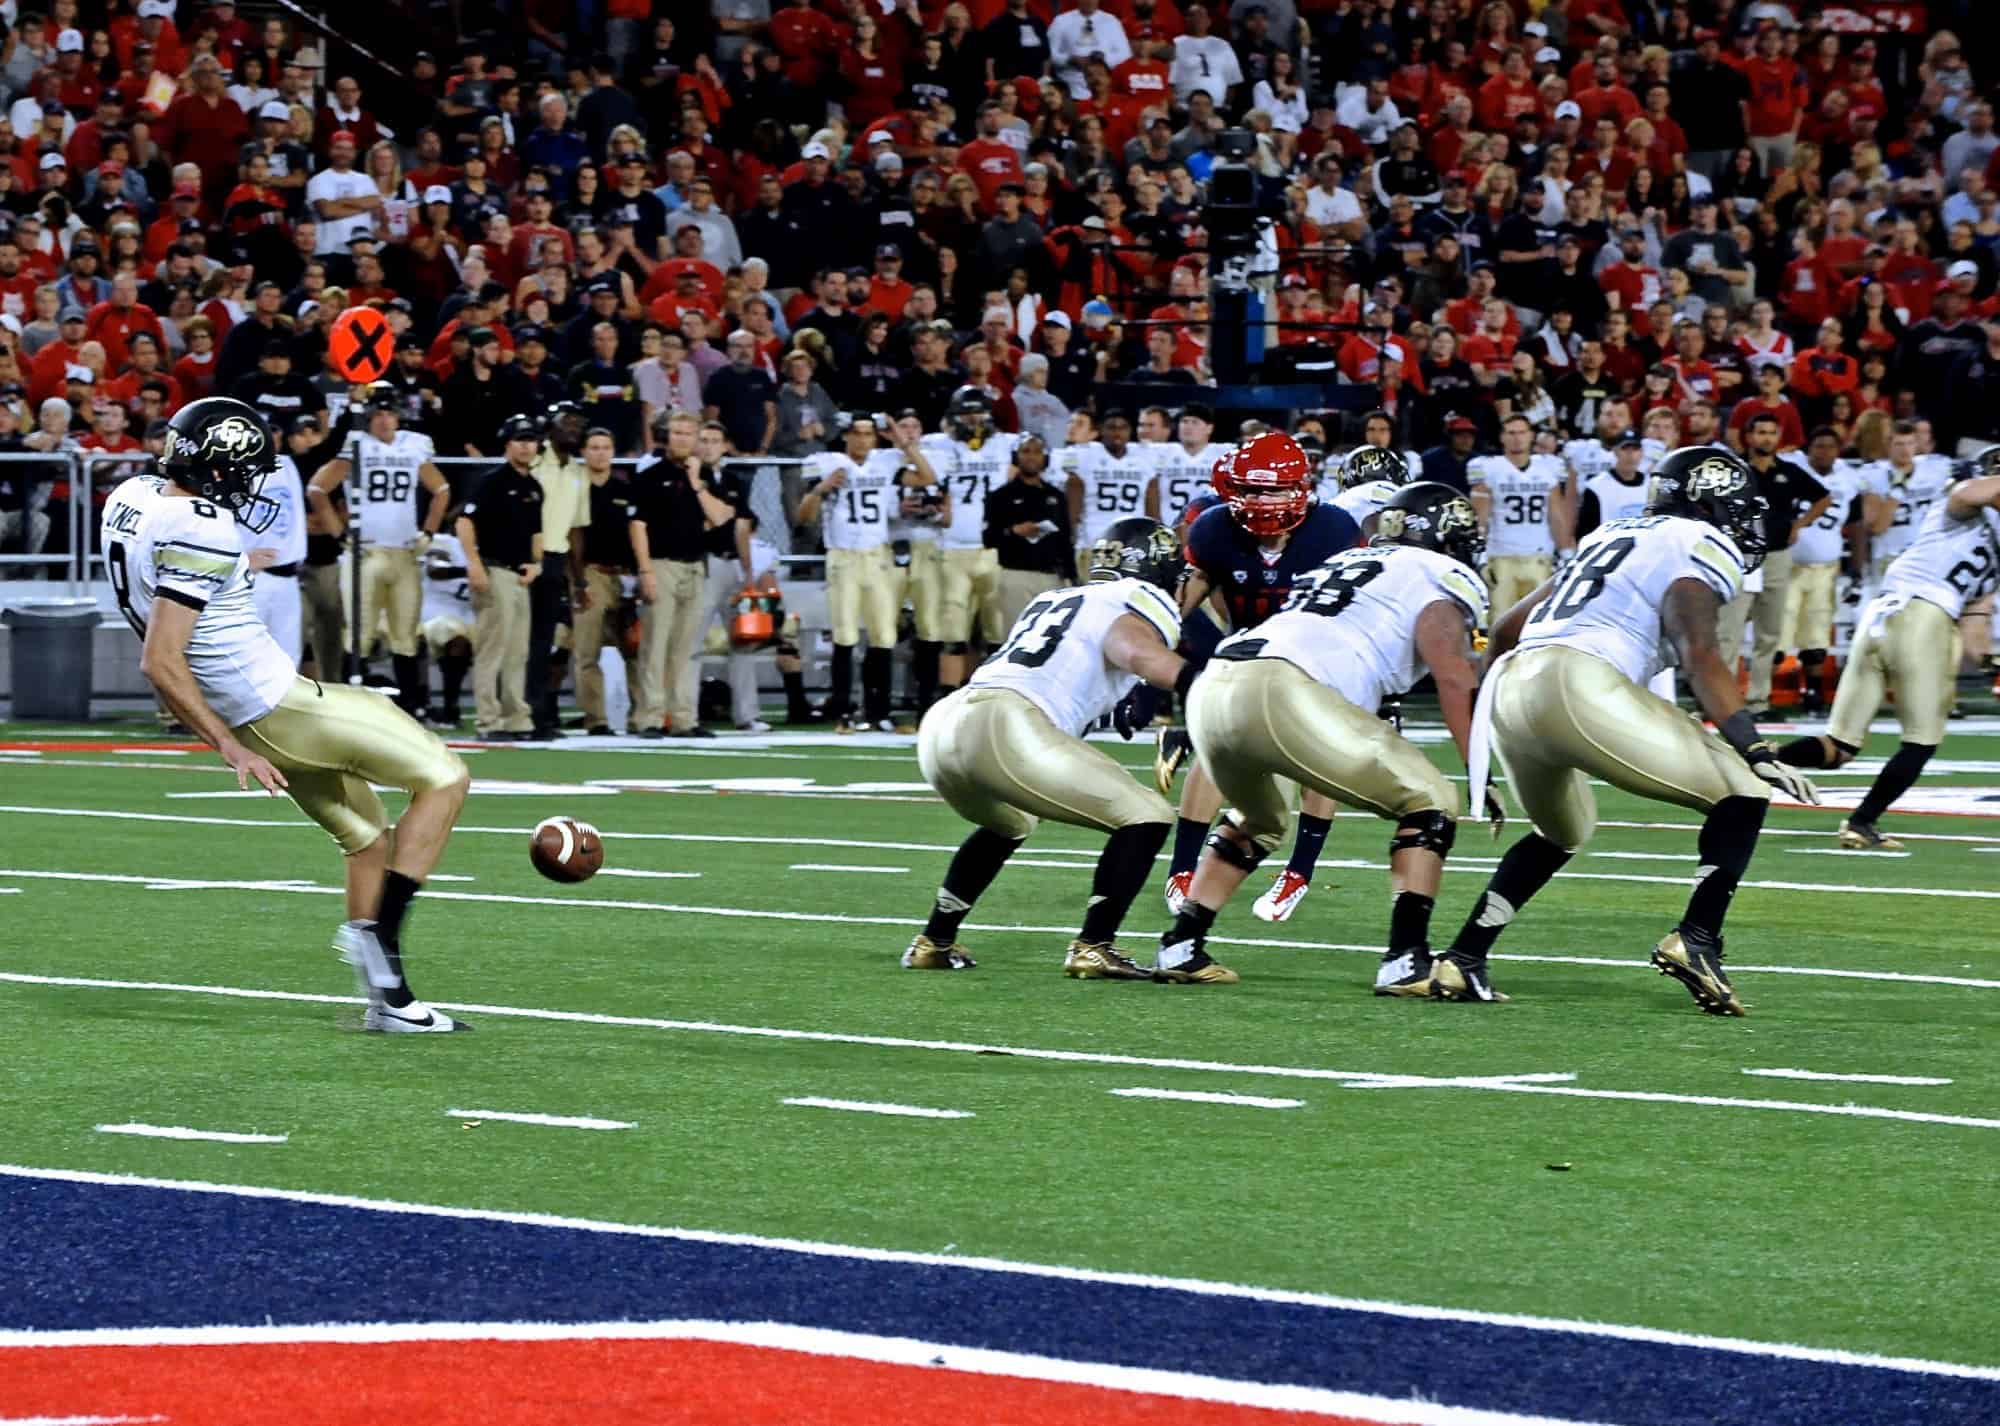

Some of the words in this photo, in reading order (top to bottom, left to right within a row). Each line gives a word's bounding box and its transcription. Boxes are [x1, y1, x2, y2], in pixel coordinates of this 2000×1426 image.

[1199, 53, 1210, 77] 1
[345, 319, 387, 373] X
[368, 470, 410, 502] 88
[1097, 483, 1140, 512] 59
[847, 489, 879, 524] 15
[1504, 495, 1545, 524] 38
